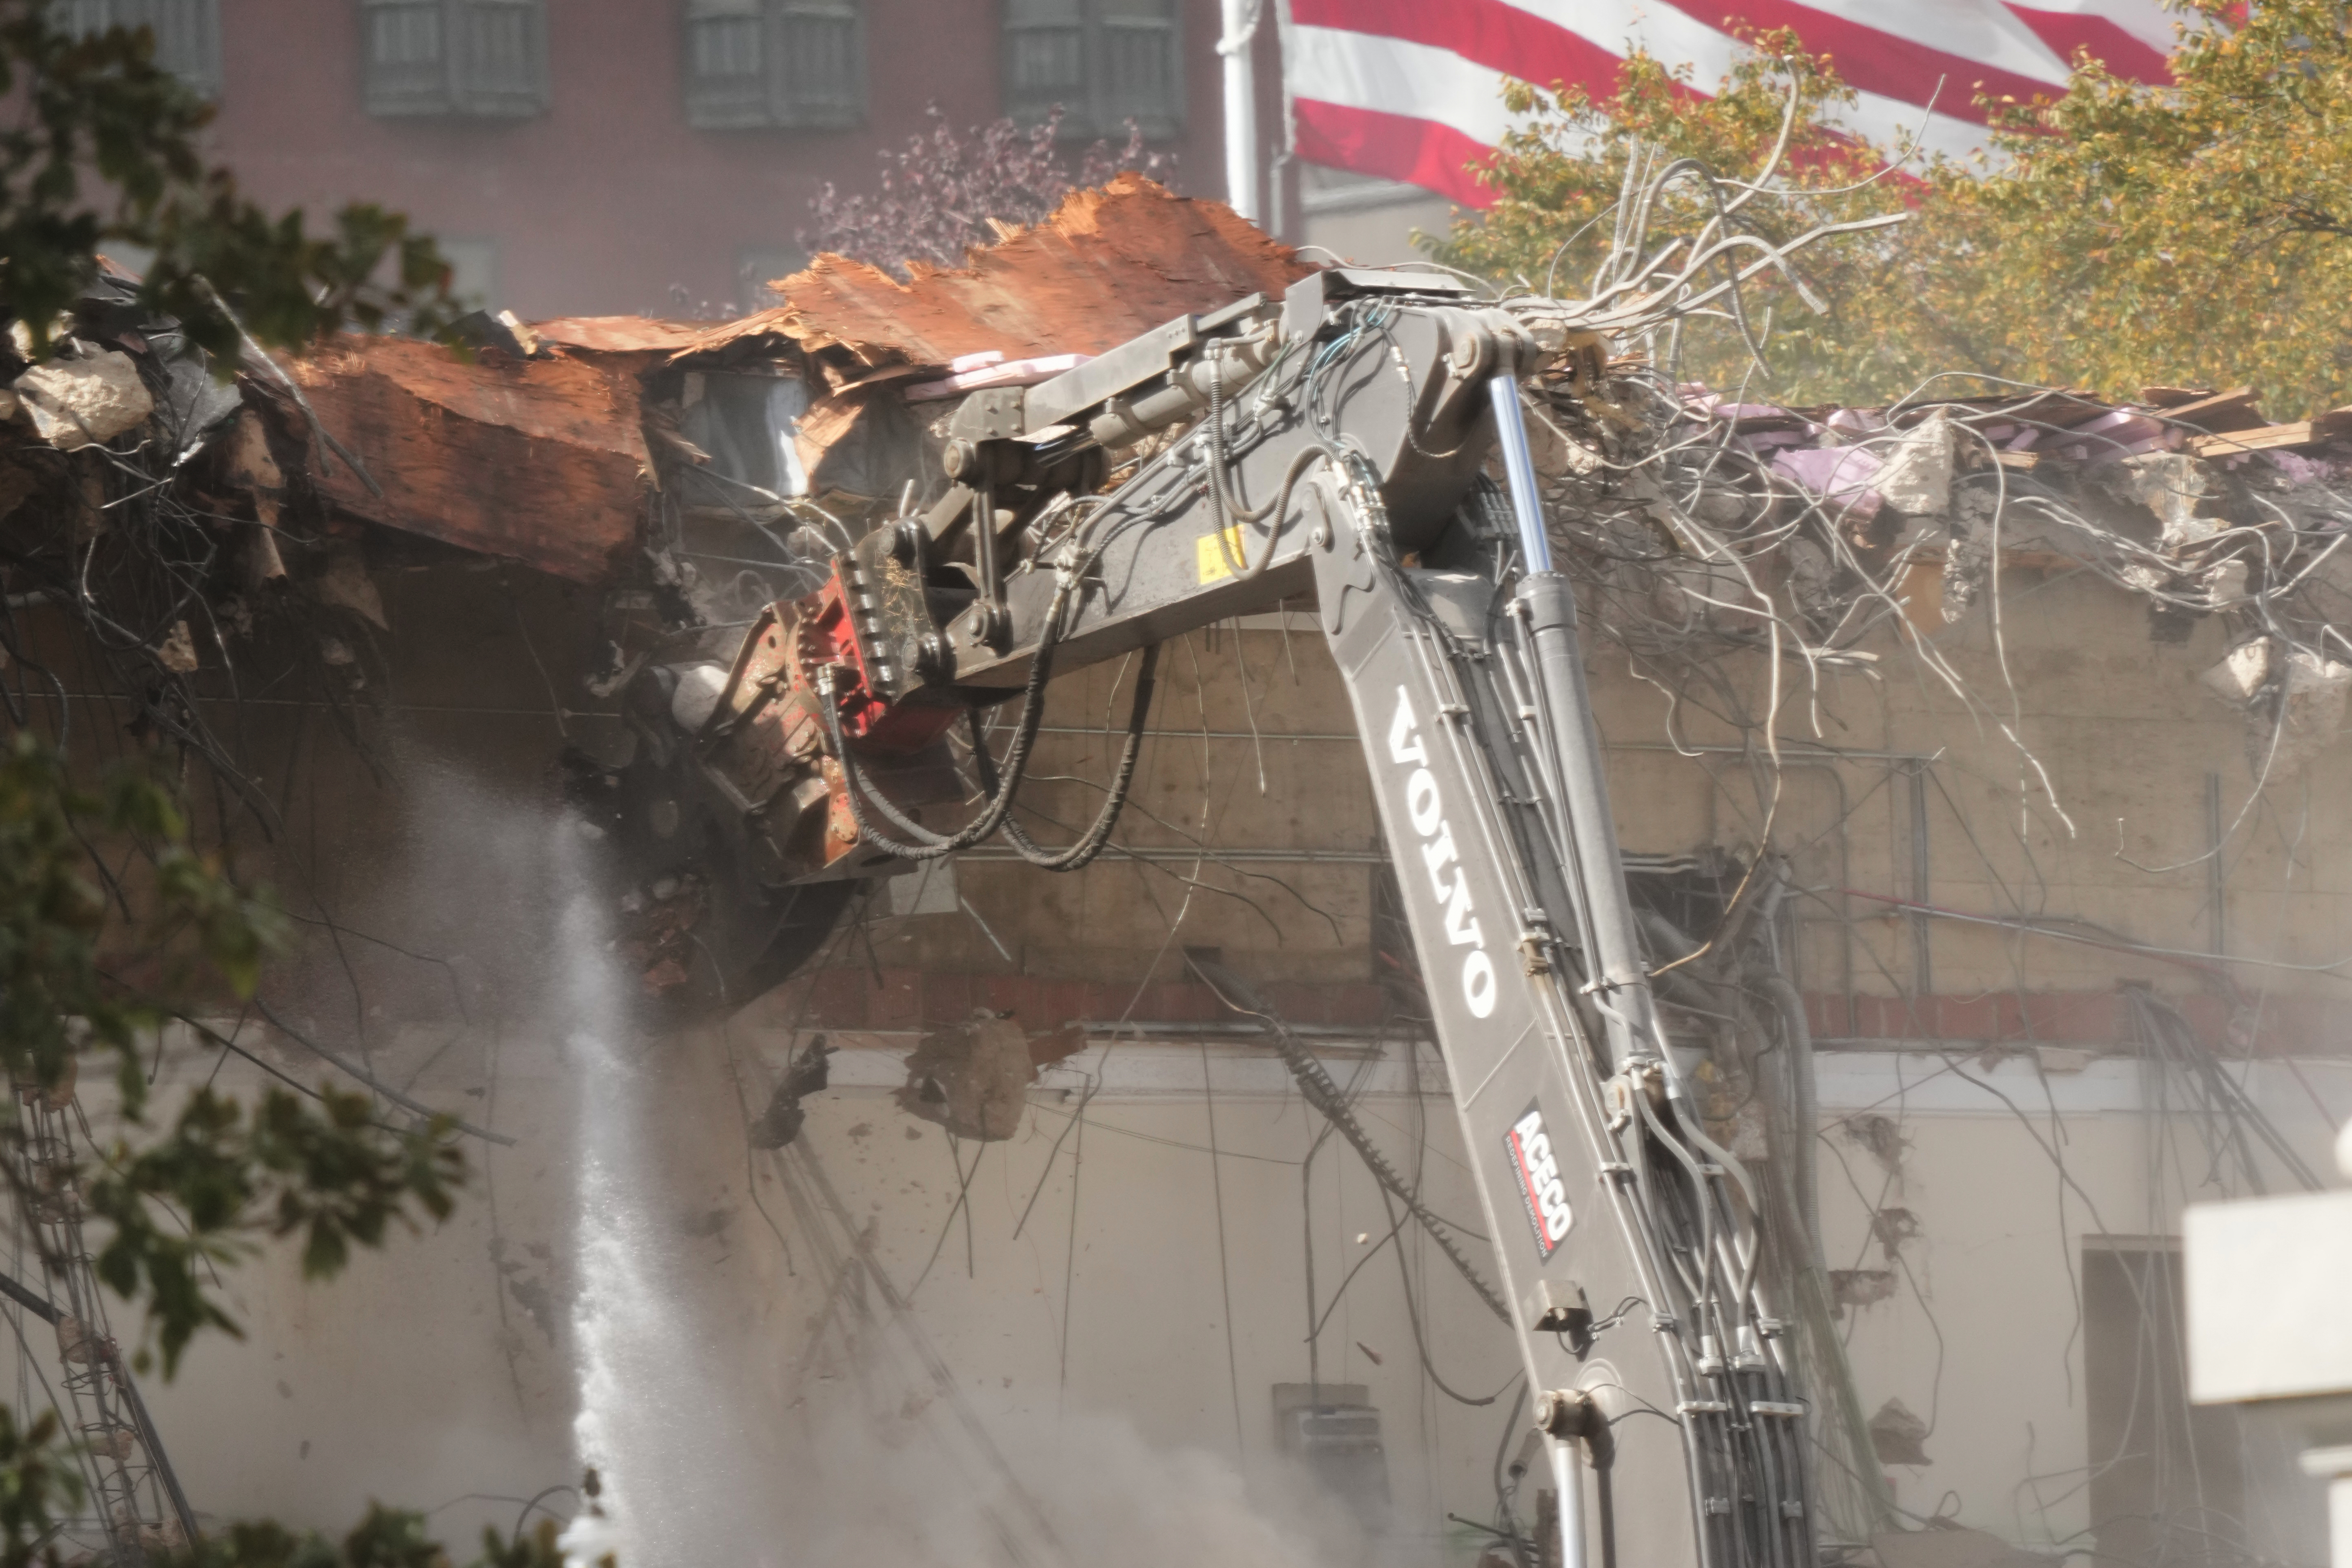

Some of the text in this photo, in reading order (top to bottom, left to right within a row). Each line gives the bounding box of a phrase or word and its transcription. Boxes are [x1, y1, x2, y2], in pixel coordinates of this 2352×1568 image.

[1389, 684, 1497, 1019] VOLVO
[1505, 1135, 1548, 1258] REDEFINING DEMOLITION
[1514, 1110, 1573, 1242] ACECO
